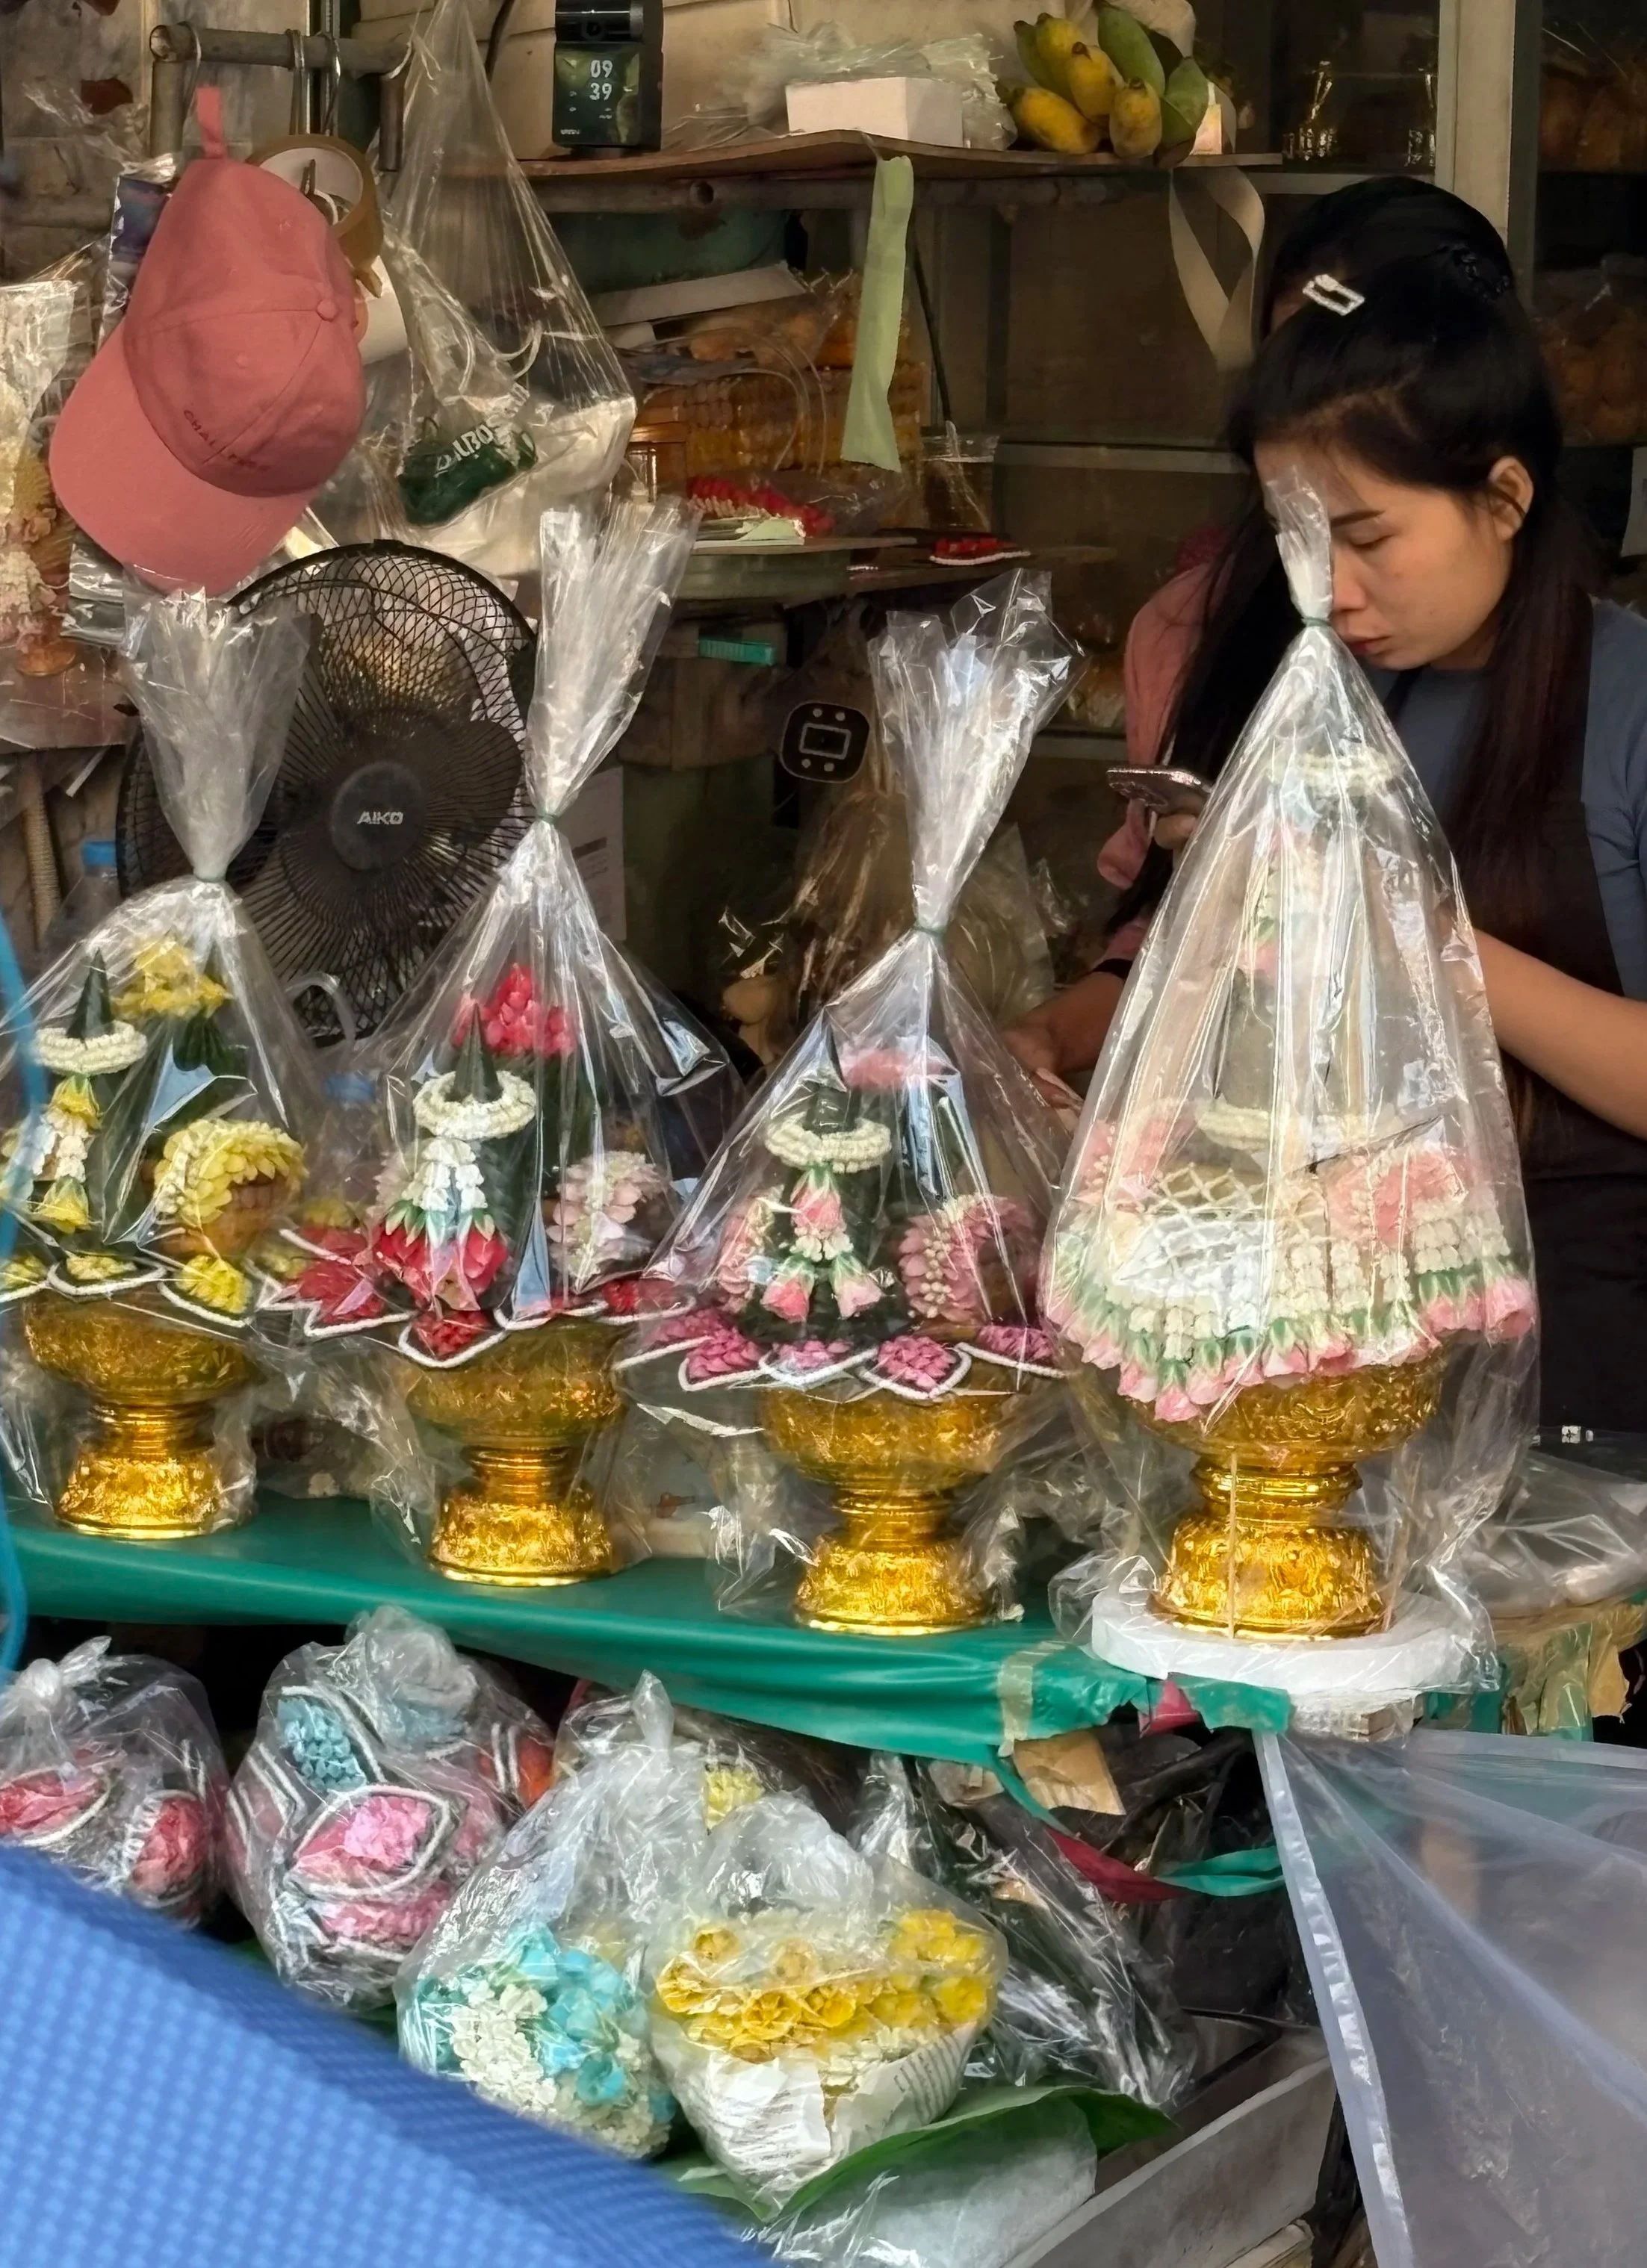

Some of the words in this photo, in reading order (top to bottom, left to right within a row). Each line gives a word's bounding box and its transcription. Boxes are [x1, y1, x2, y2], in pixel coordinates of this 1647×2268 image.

[590, 59, 613, 78] 09
[589, 82, 612, 101] 39
[356, 811, 404, 825] AIKO
